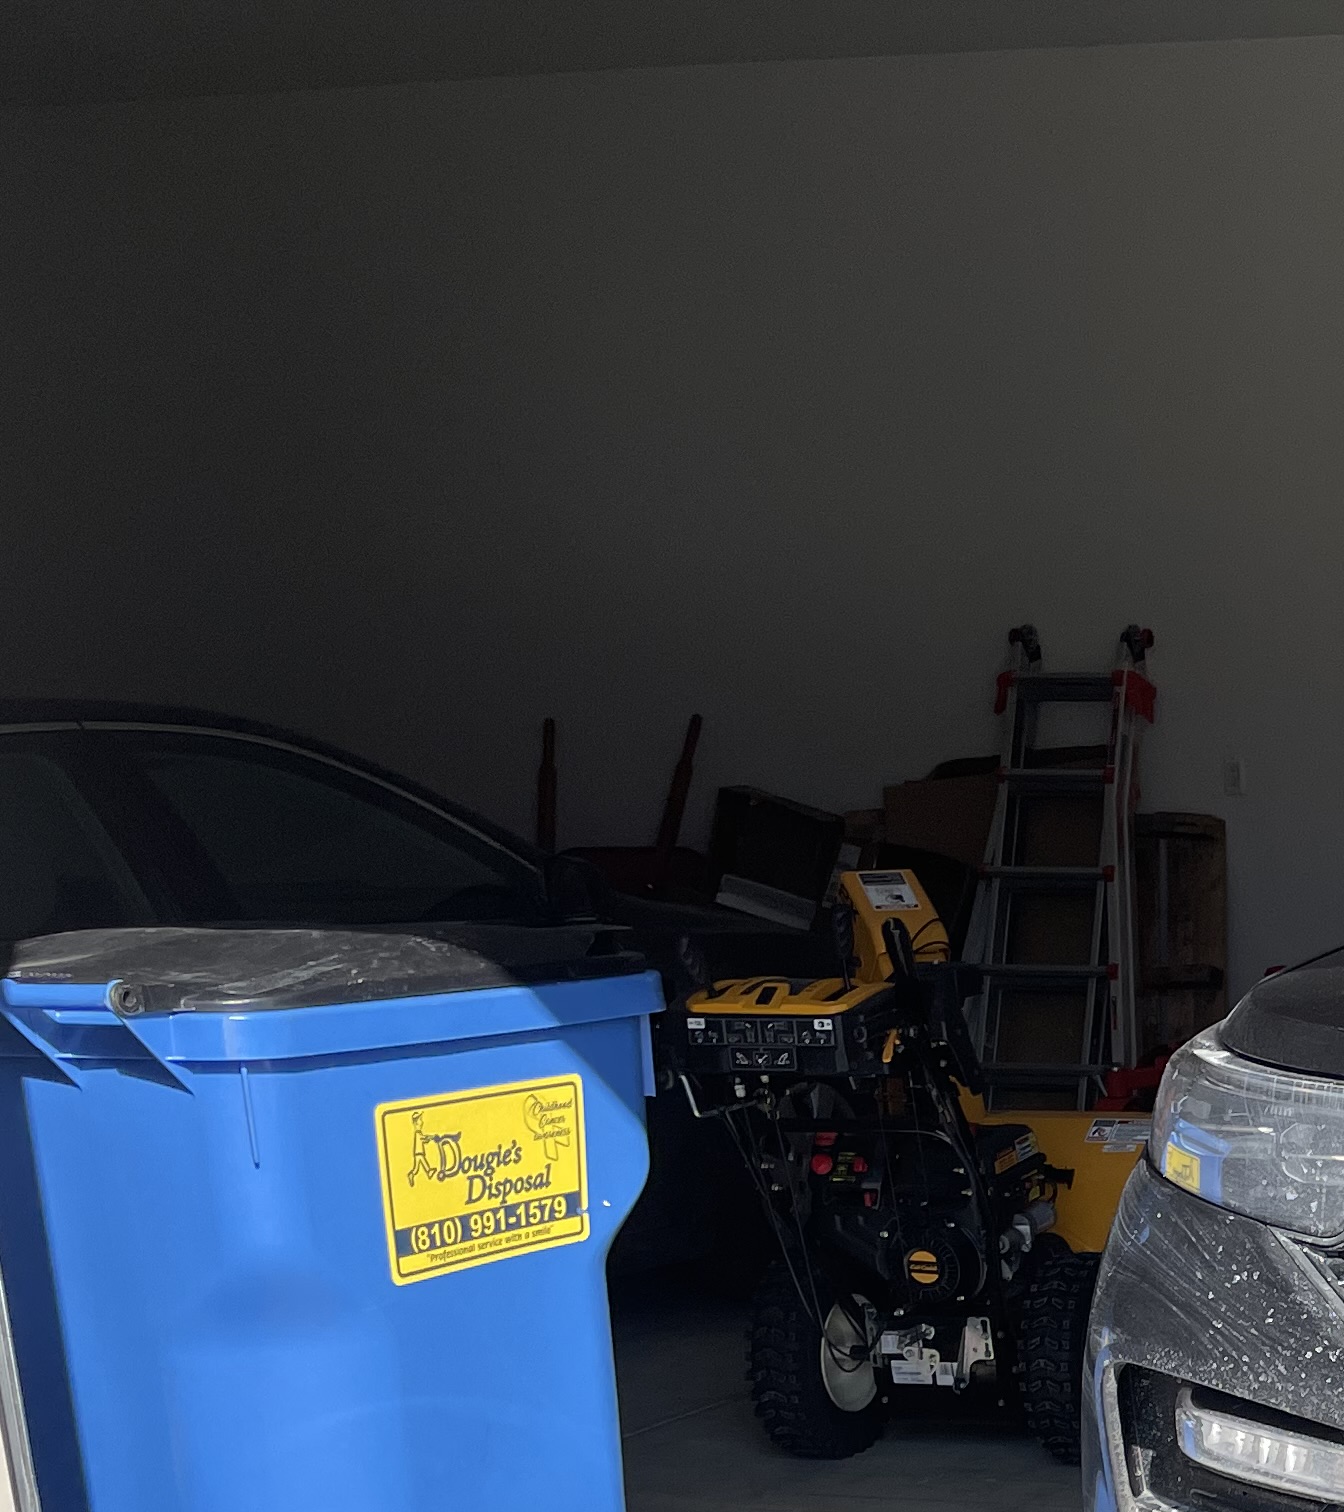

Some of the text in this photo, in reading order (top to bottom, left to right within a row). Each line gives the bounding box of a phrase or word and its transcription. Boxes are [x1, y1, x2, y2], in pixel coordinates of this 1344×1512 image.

[533, 1098, 573, 1116] Childhood
[539, 1113, 565, 1128] Cancer
[437, 1138, 523, 1179] Dougie's
[465, 1164, 552, 1205] Disposal
[410, 1196, 567, 1253] (810) 991-1579
[478, 1238, 502, 1251] service
[506, 1233, 522, 1244] with
